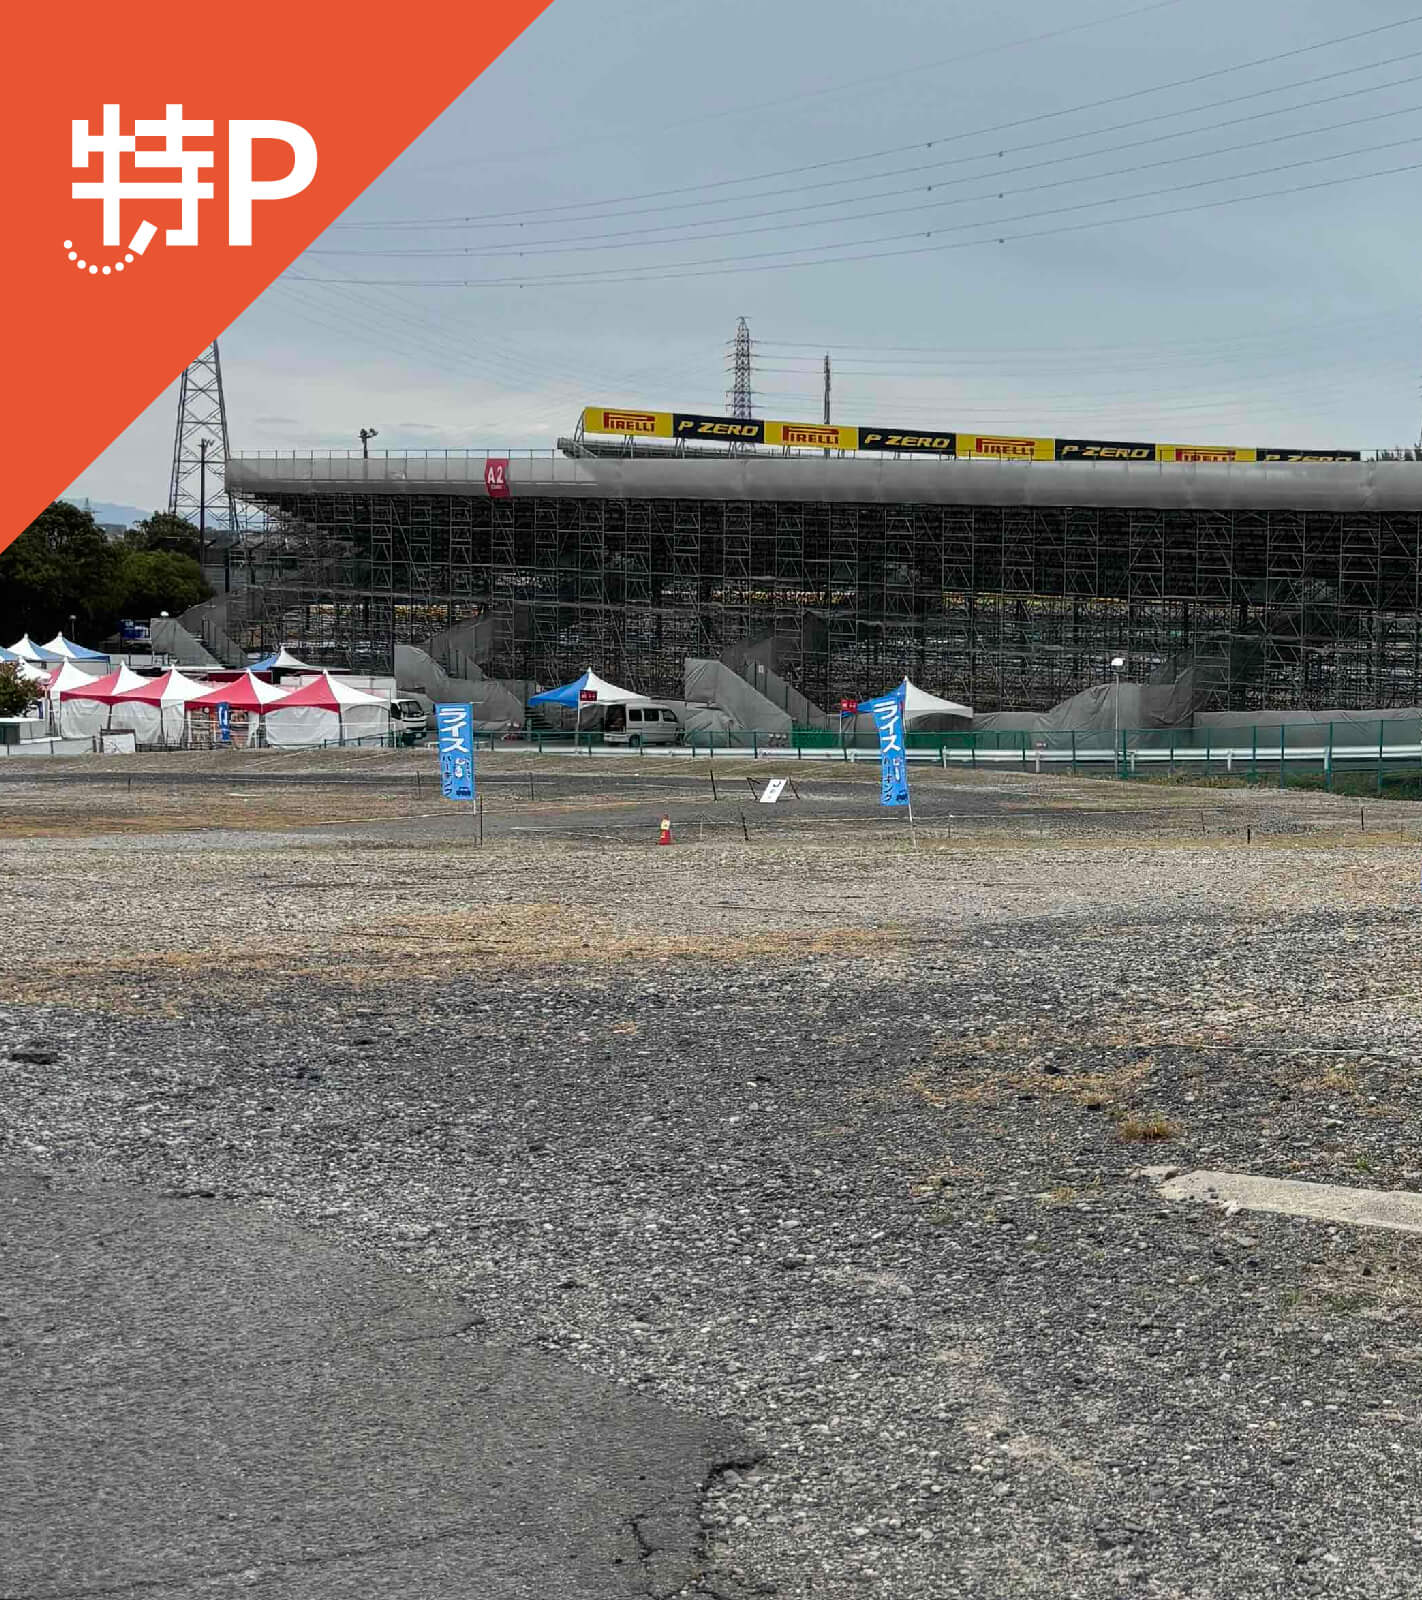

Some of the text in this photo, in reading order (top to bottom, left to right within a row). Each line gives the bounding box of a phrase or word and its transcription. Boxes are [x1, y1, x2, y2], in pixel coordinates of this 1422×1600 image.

[603, 411, 656, 433] PIRELLI
[678, 420, 759, 437] P ZERO
[782, 424, 840, 445] PIRELLI
[864, 433, 951, 449] P ZERO
[975, 437, 1035, 456] PIRELLI
[1061, 445, 1150, 458] P ZERO
[487, 465, 504, 484] A2
[440, 707, 470, 753] ライス
[872, 699, 902, 754] ライス
